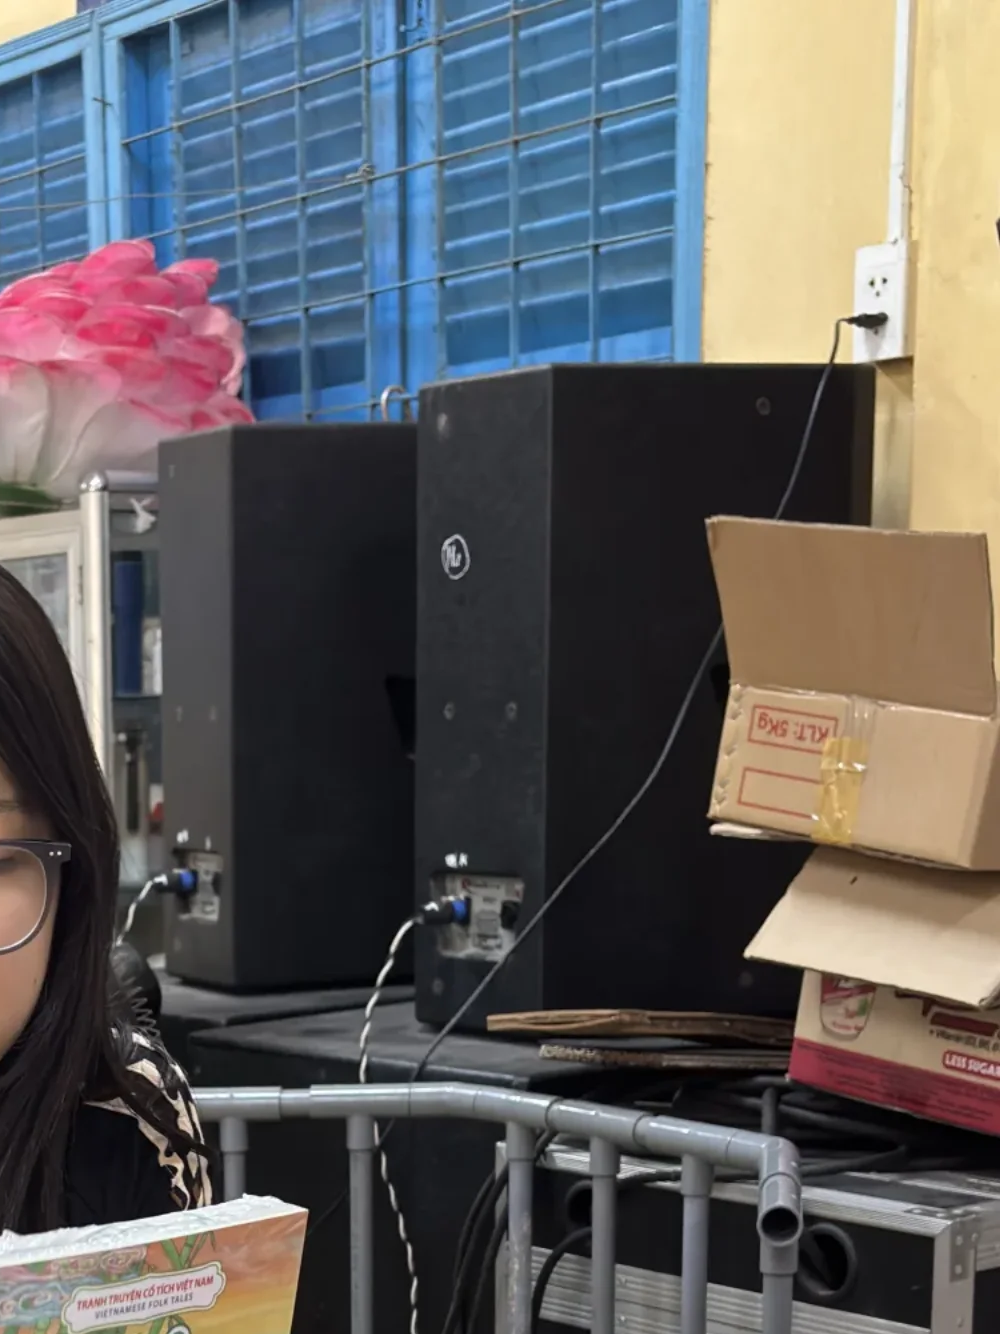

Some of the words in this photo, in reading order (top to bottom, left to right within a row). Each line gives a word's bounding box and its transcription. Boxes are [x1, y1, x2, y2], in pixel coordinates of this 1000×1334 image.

[757, 712, 788, 737] 5Kg
[789, 721, 830, 745] KLT:
[944, 1053, 967, 1069] LESS
[76, 1298, 107, 1312] TRANH
[157, 1283, 174, 1296] TÍCH
[174, 1279, 194, 1293] VIỆT
[194, 1275, 214, 1288] NAM
[94, 1301, 146, 1319] VIETNAMESE
[147, 1297, 169, 1309] FOLK
[171, 1292, 194, 1304] TALES
